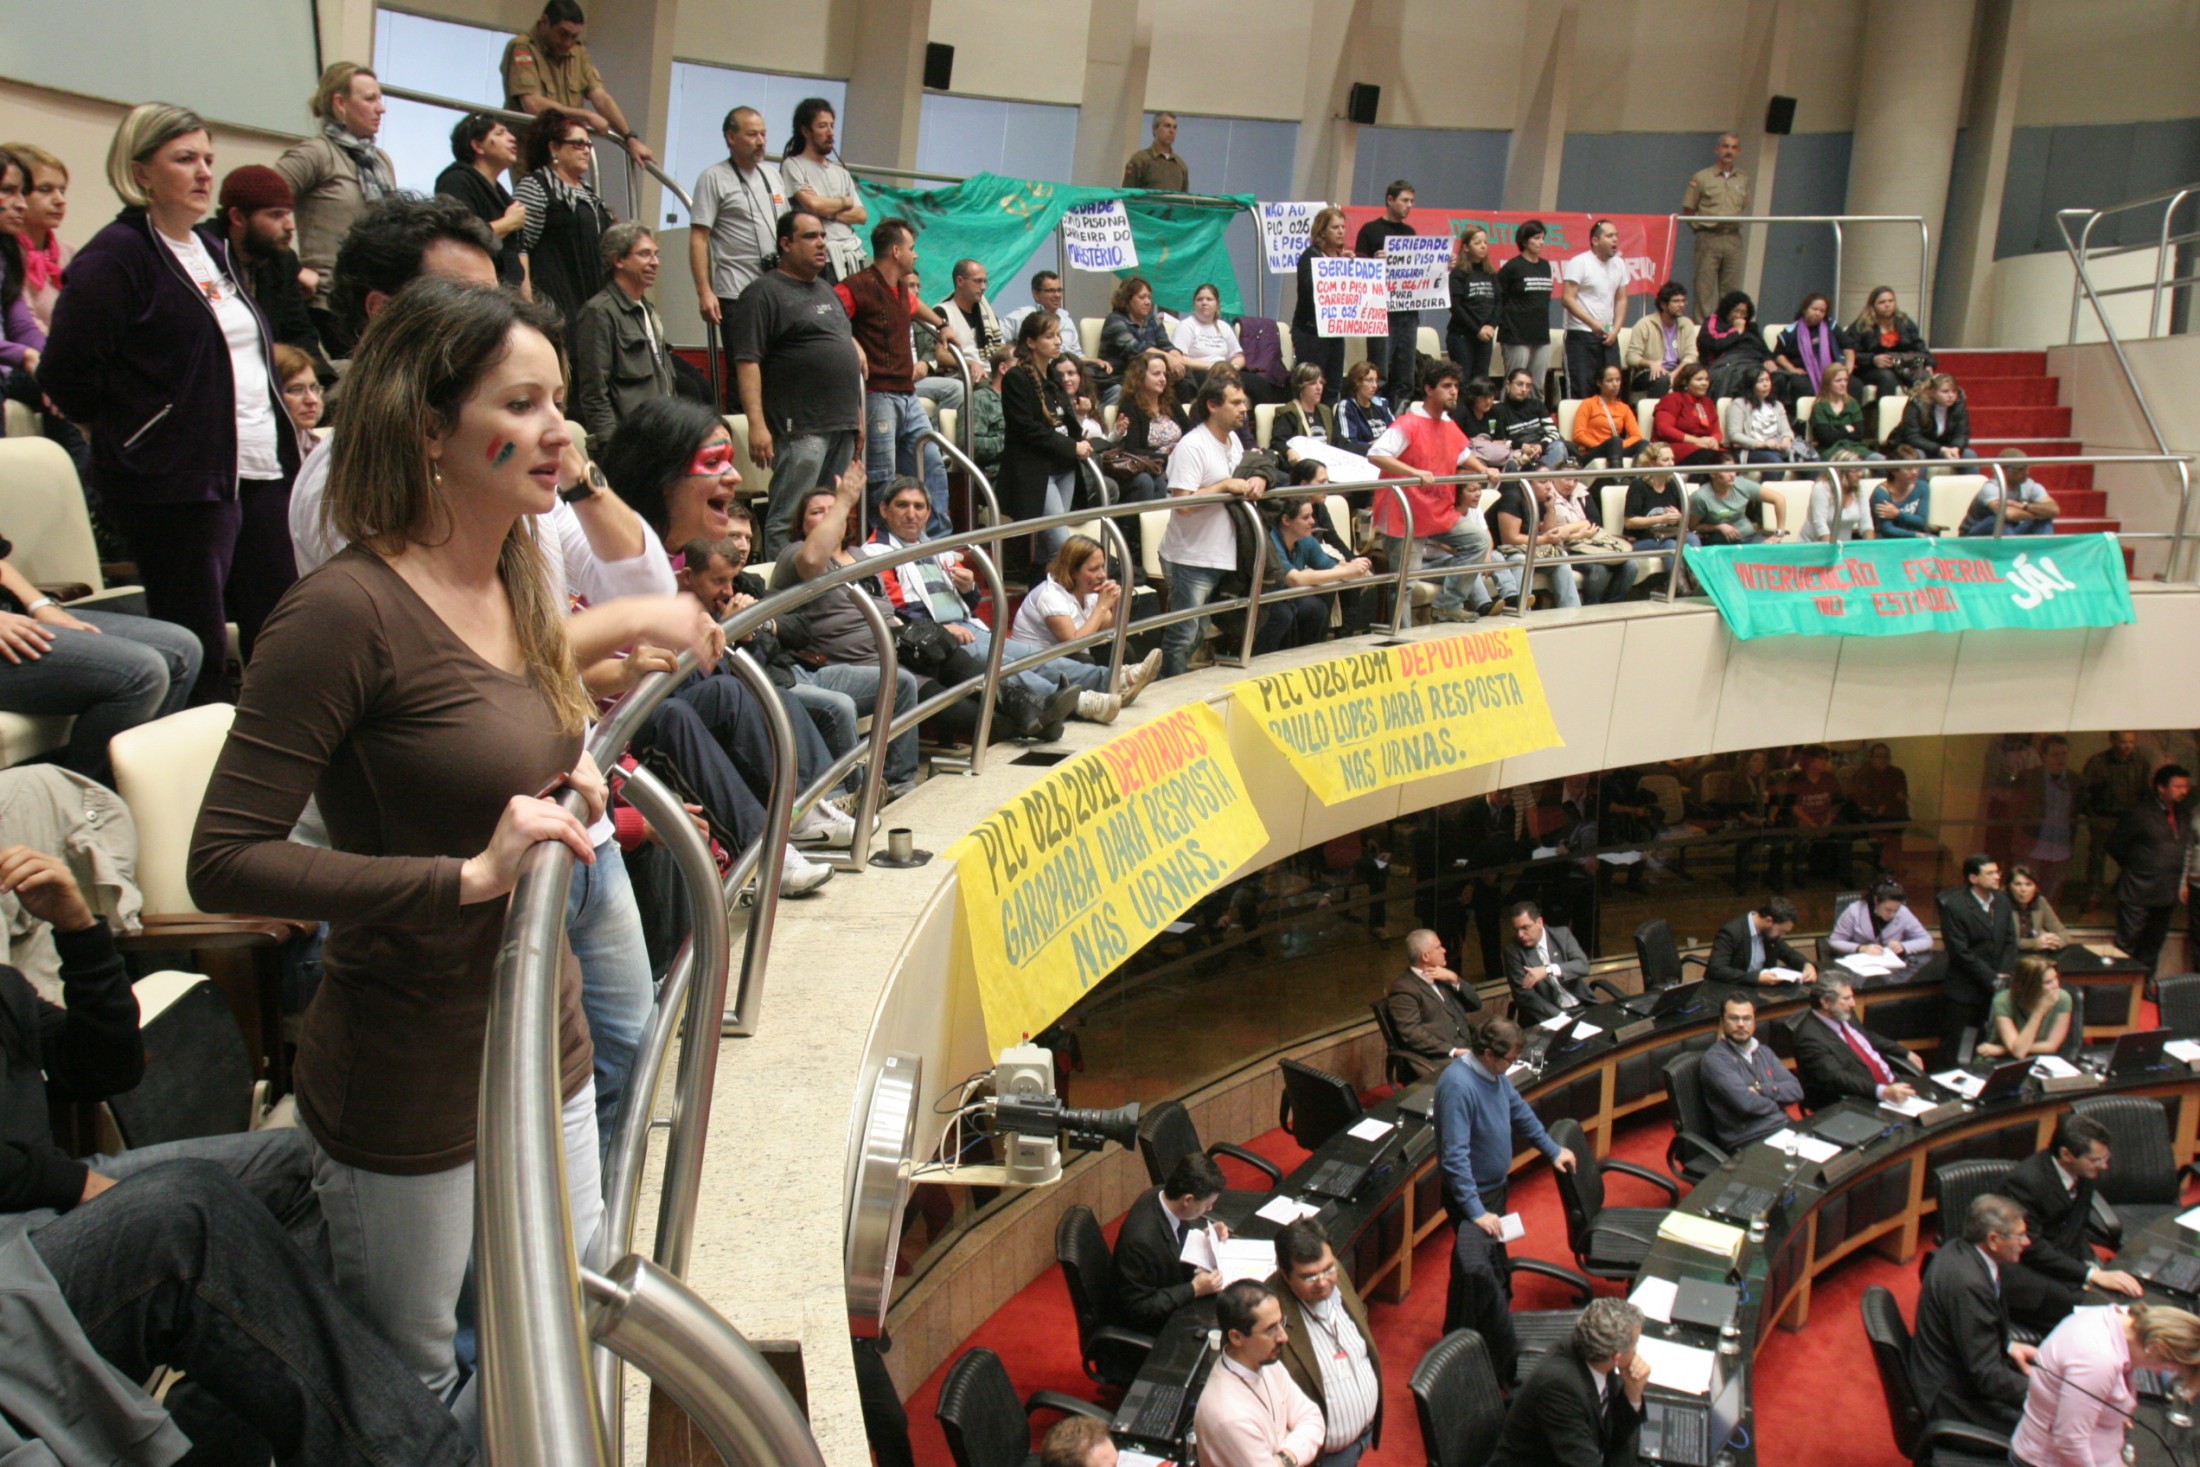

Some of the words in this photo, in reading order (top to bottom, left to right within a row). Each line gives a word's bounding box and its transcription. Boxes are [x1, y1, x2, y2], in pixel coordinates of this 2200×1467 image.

[1265, 203, 1284, 218] NÃO
[1288, 205, 1306, 217] AO
[1083, 217, 1106, 228] PISO
[1108, 216, 1126, 227] NA
[1267, 221, 1283, 236] PLC
[1289, 218, 1310, 234] 026
[1113, 230, 1130, 242] DO
[1388, 238, 1449, 252] SERIEDADE
[1269, 256, 1280, 268] NA
[1387, 254, 1405, 266] COM
[1406, 255, 1412, 265] O
[1414, 253, 1434, 266] PISO
[1437, 253, 1451, 263] NA
[1318, 260, 1383, 280] SERIEDADE
[1317, 280, 1337, 294] COM
[1341, 280, 1347, 292] O
[1349, 281, 1368, 295] PISO
[1372, 283, 1384, 296] NA
[1401, 279, 1430, 291] 026/11
[1389, 290, 1413, 301] PURA
[1321, 307, 1338, 320] PLC
[1341, 305, 1358, 319] 026
[1368, 307, 1387, 321] PURA
[1733, 557, 1881, 593] INTERVENÇÃO
[1902, 556, 2006, 585] FEDERAL
[2005, 552, 2078, 611] JÁ!
[1812, 594, 1846, 616] NO
[1874, 586, 1959, 617] ESTADO
[1254, 671, 1303, 713] PLC
[1399, 629, 1514, 678] DEPUTADOS:
[1329, 697, 1379, 744] LOPES
[1380, 681, 1426, 731] DARÁ
[1427, 671, 1524, 721] RESPOSTA
[1339, 747, 1378, 793] NAS
[1381, 727, 1467, 778] URNAS.
[969, 809, 1028, 897] PLC
[1001, 836, 1104, 966] GAROPABA
[1096, 790, 1153, 884] DARÁ
[1149, 756, 1238, 846] RESPOSTA
[1070, 900, 1130, 989] NAS
[1128, 837, 1229, 931] URNAS.
